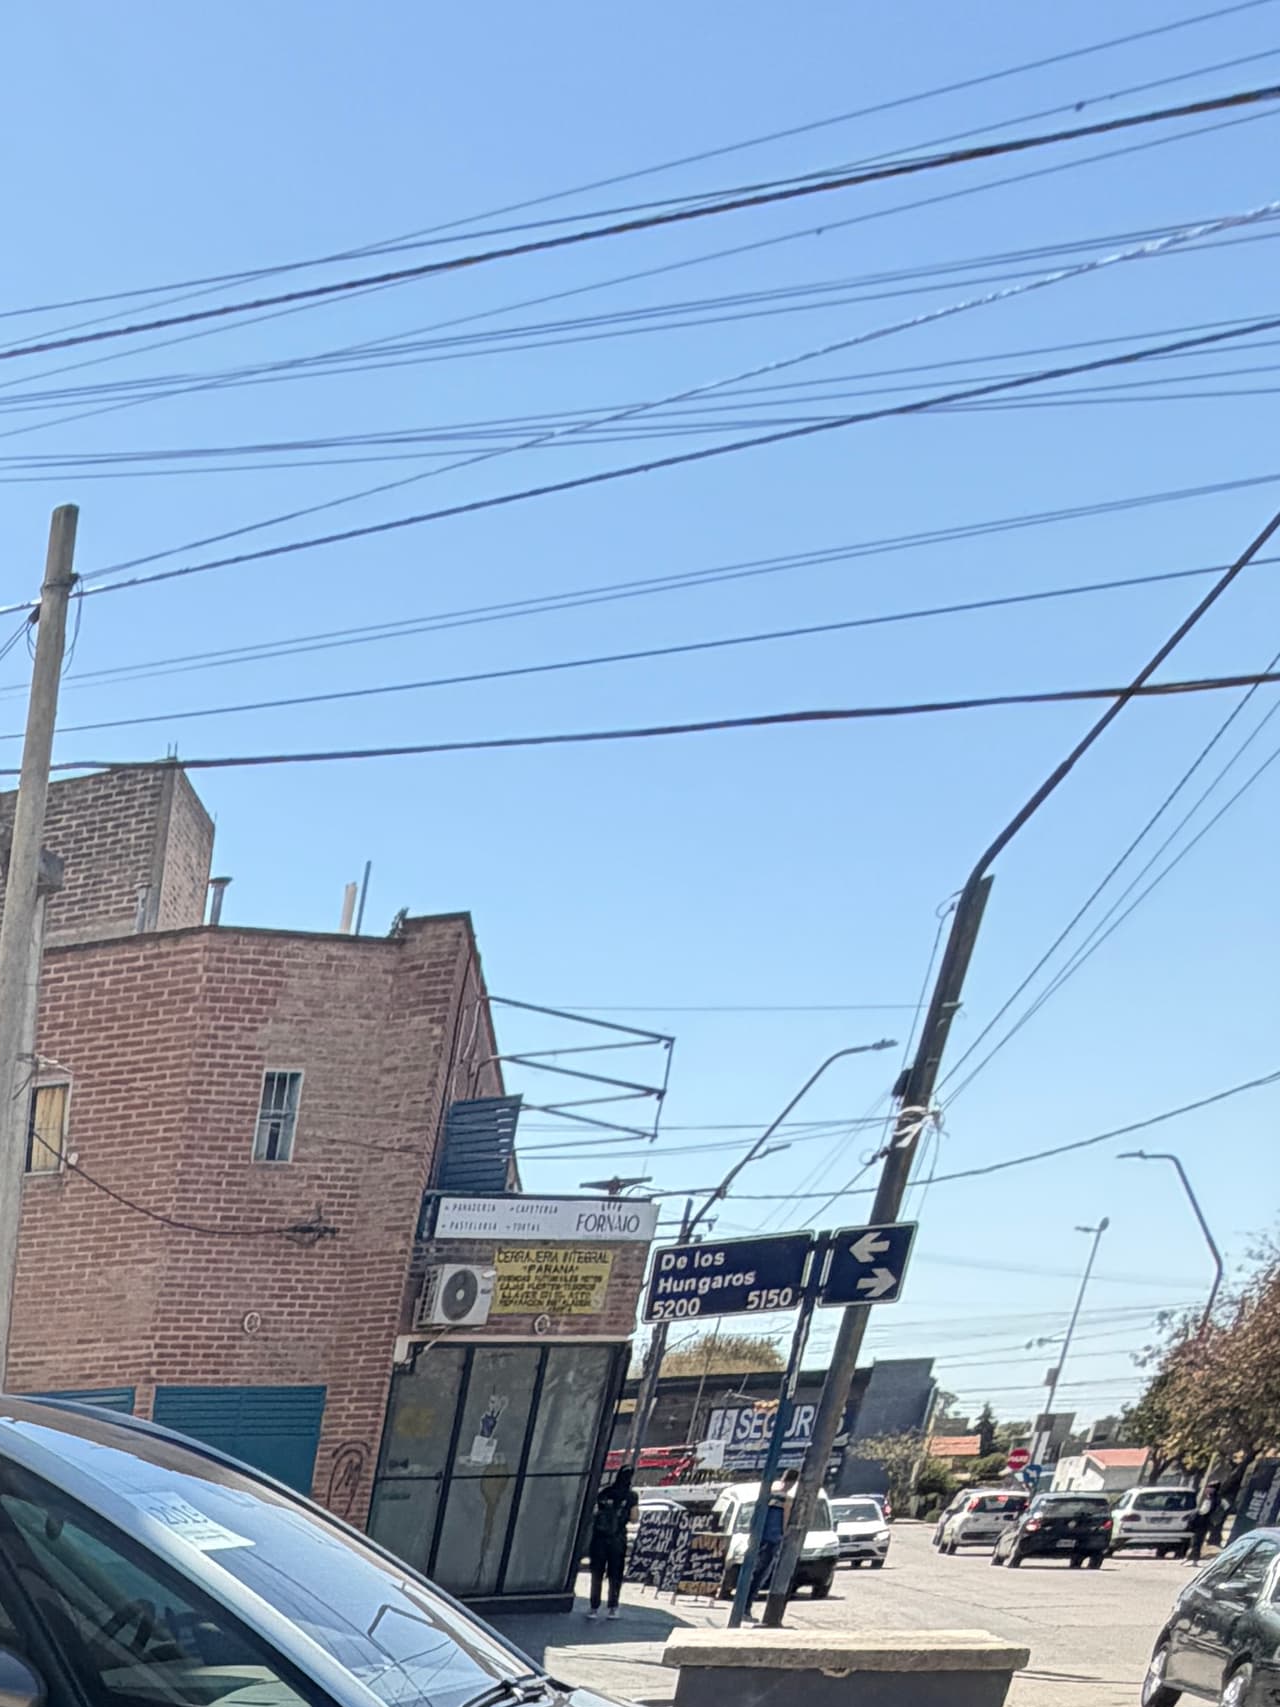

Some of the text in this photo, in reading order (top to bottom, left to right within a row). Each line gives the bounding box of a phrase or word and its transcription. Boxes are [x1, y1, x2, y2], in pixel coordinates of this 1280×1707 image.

[576, 1213, 640, 1232] FORNAIO
[661, 1251, 725, 1271] De los
[657, 1271, 756, 1294] Hungaros
[652, 1288, 792, 1319] 5200 5150
[736, 1405, 844, 1440] SEGUR
